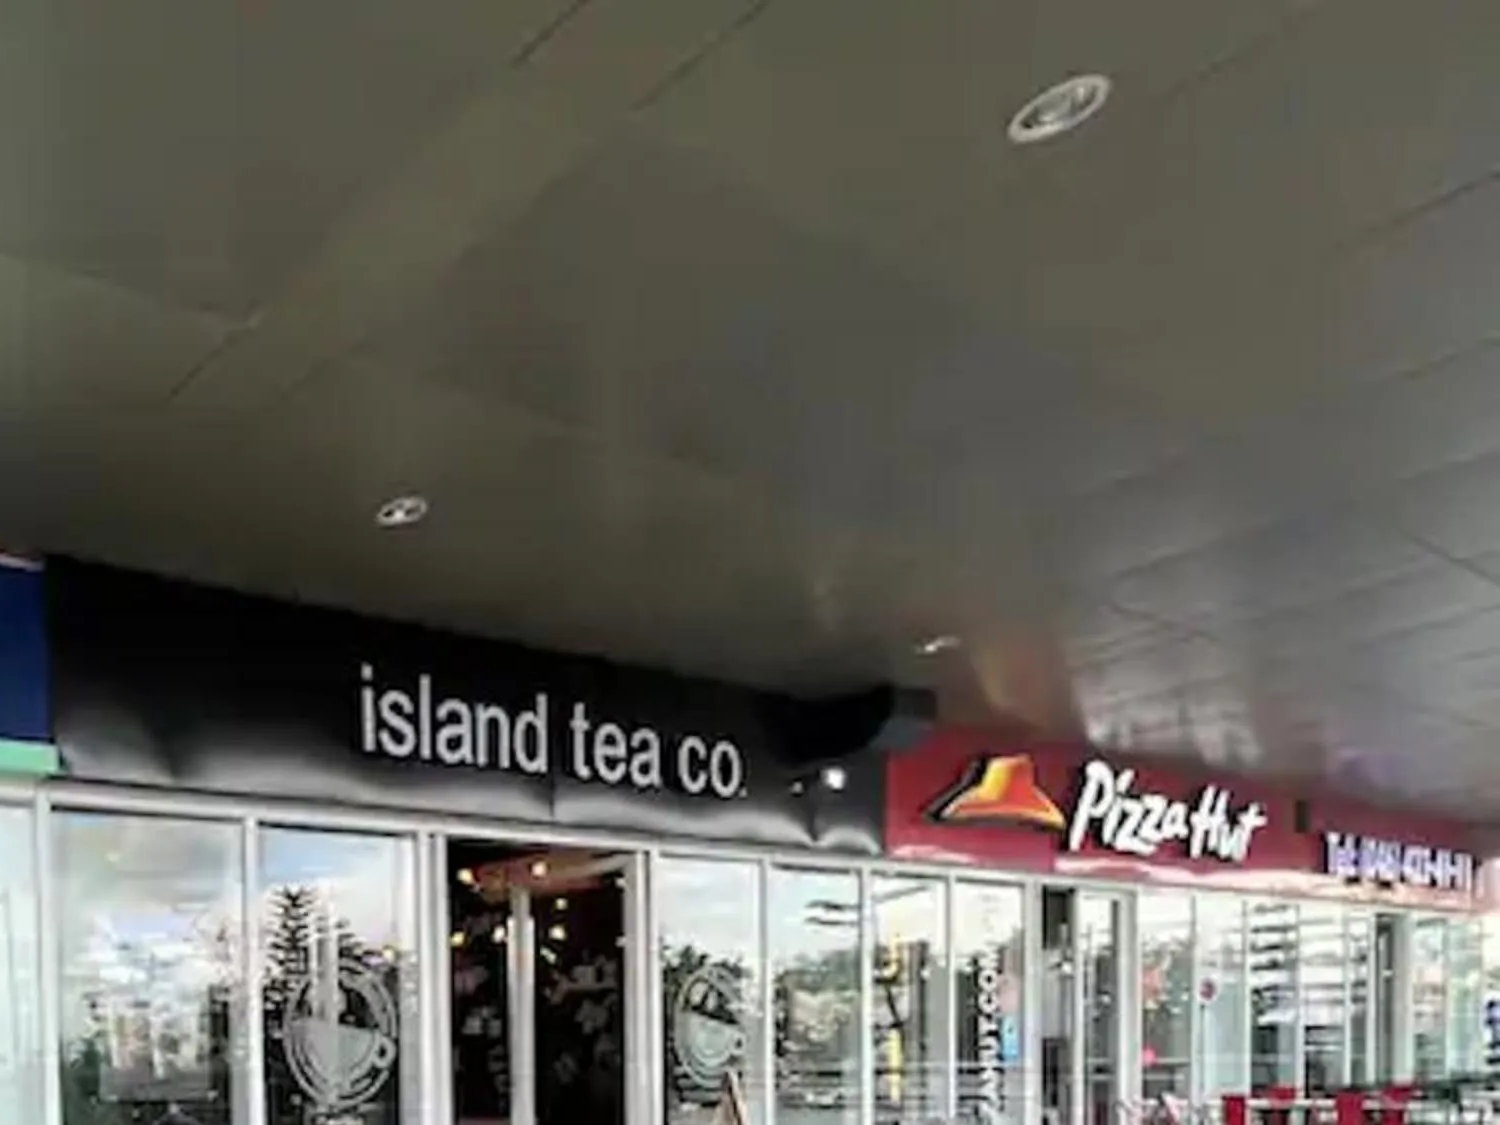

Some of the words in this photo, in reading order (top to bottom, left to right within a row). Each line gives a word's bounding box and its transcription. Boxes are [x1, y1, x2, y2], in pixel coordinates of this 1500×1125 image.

[360, 662, 549, 774] island
[570, 702, 661, 788] tea
[677, 735, 748, 798] co.
[1068, 759, 1190, 857] Pizza
[1189, 785, 1268, 862] Hut
